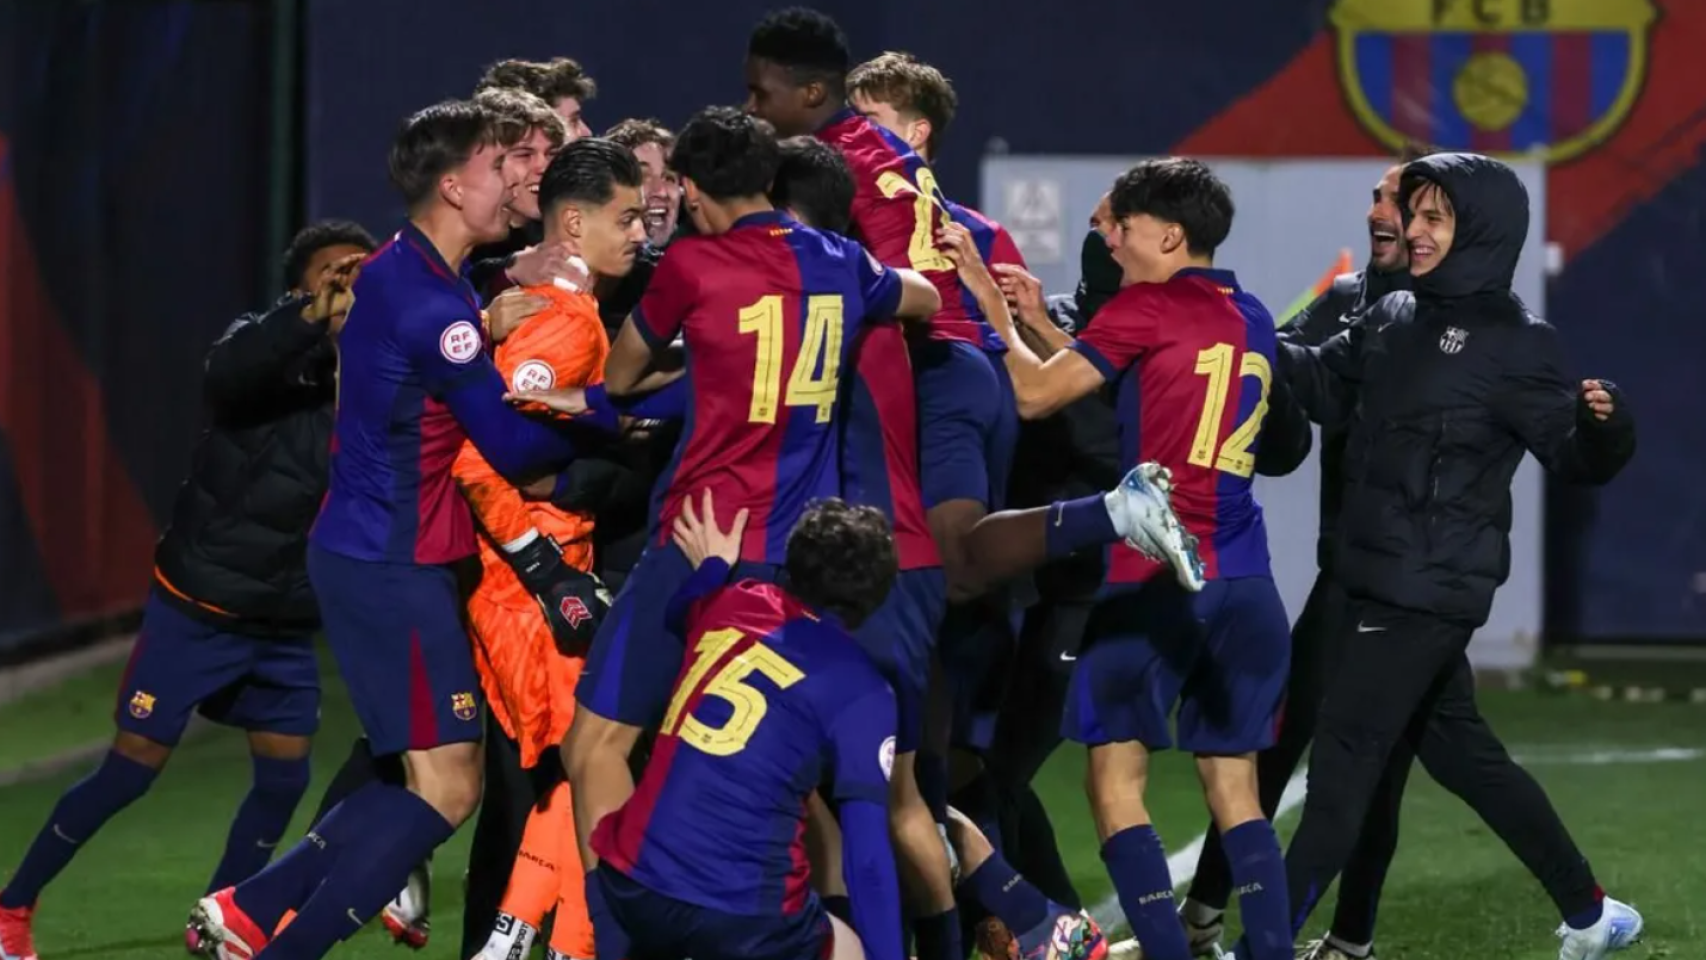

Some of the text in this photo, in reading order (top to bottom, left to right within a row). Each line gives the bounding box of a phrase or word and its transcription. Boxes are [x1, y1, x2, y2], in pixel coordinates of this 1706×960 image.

[1431, 0, 1550, 26] FCB
[738, 294, 843, 424] 14
[1187, 342, 1273, 478] 12
[660, 626, 806, 756] 15
